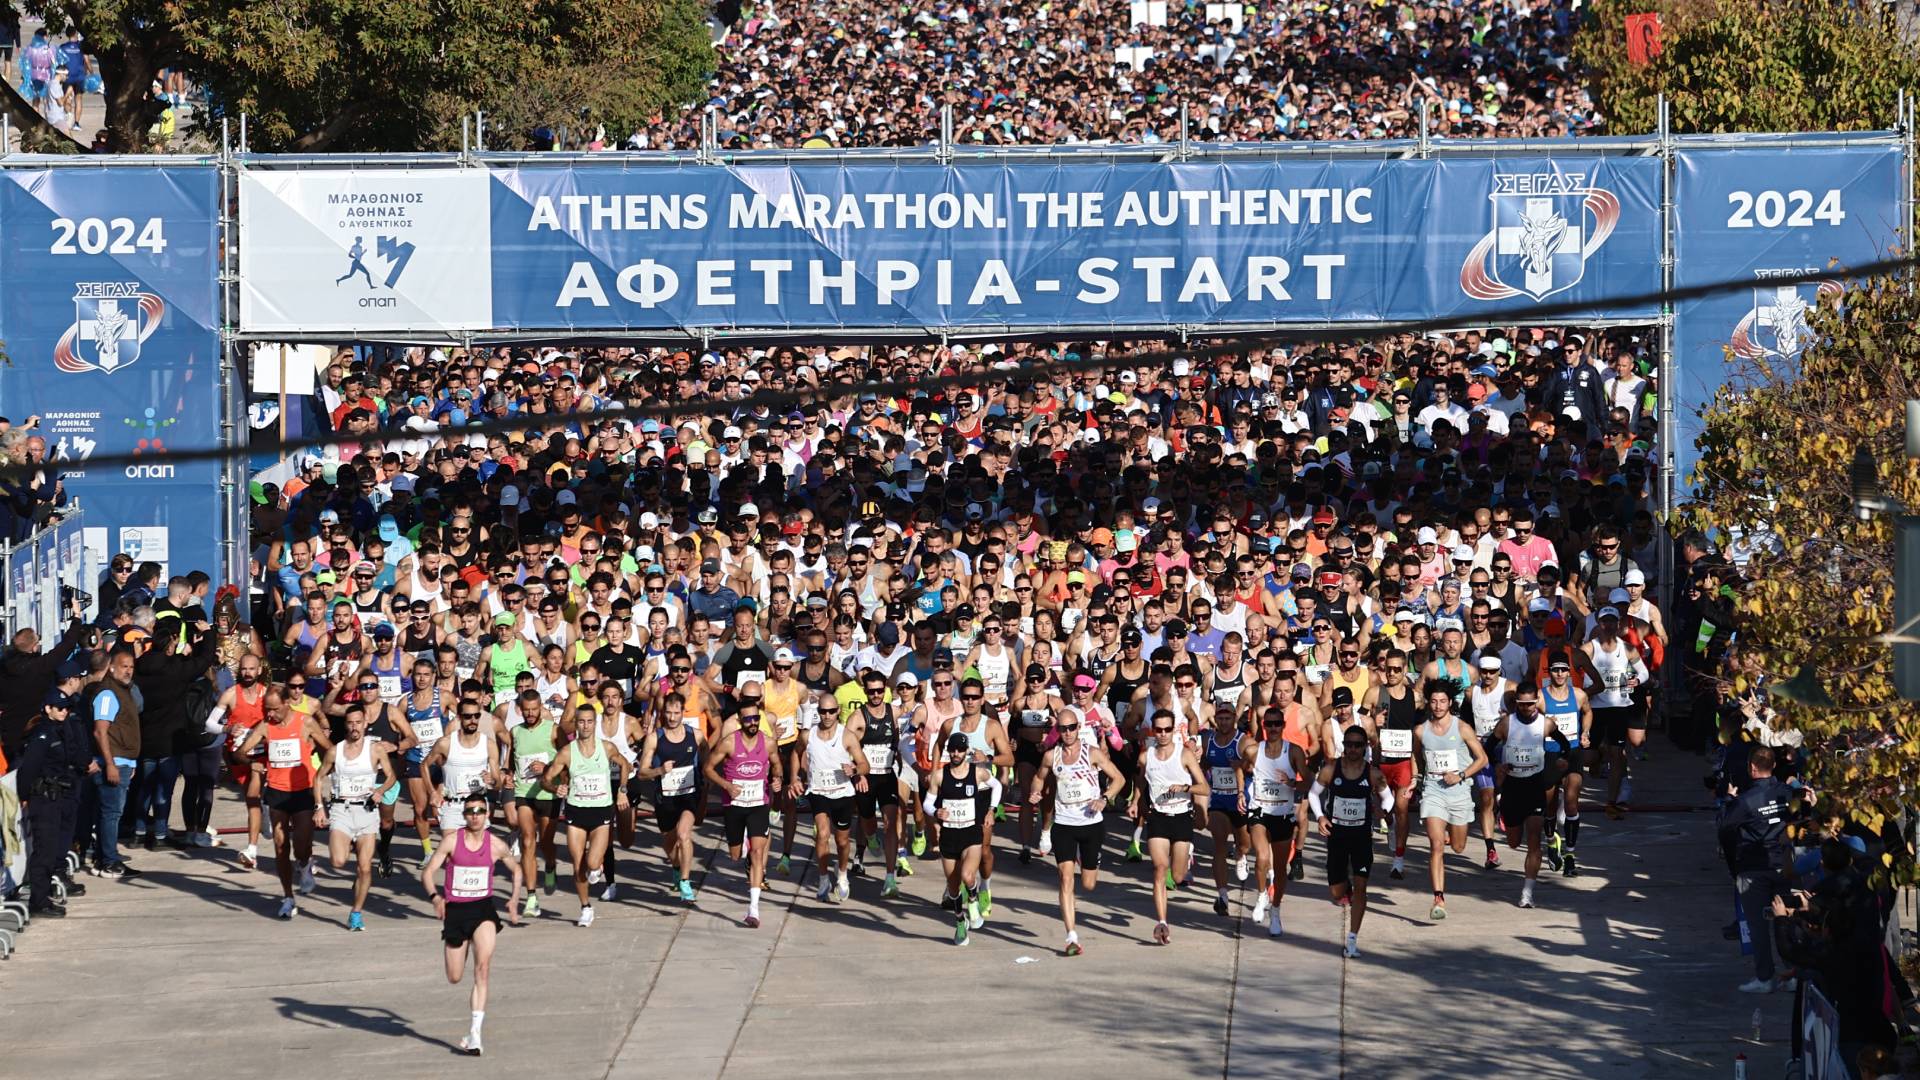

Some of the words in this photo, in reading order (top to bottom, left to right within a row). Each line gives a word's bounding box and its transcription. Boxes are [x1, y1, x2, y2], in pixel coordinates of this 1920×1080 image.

[1494, 173, 1585, 194] ΣΕΓΑΣ
[328, 193, 423, 204] ΜΑΡΑΘΩΝΙΟΣ
[346, 206, 406, 217] ΑΘΗΝΑΣ
[527, 194, 708, 231] ATHENS
[728, 193, 1006, 229] MARATHON.
[1017, 192, 1104, 228] THE
[1114, 187, 1373, 227] AUTHENTIC
[1727, 189, 1846, 228] 2024
[349, 219, 413, 228] ΑΥΘΕΝΤΙΚΟΣ
[50, 217, 168, 255] 2024
[75, 282, 140, 298] ΣΕΓΑΣ
[1032, 714, 1042, 722] 52
[420, 729, 434, 737] 402
[1390, 739, 1404, 747] 129
[1515, 754, 1530, 762] 115
[821, 778, 836, 787] 113
[1219, 777, 1233, 785] 135
[742, 789, 755, 797] 111
[1067, 791, 1081, 799] 339
[1264, 788, 1280, 797] 102
[952, 810, 966, 818] 104
[1343, 808, 1358, 816] 106
[463, 877, 480, 886] 499
